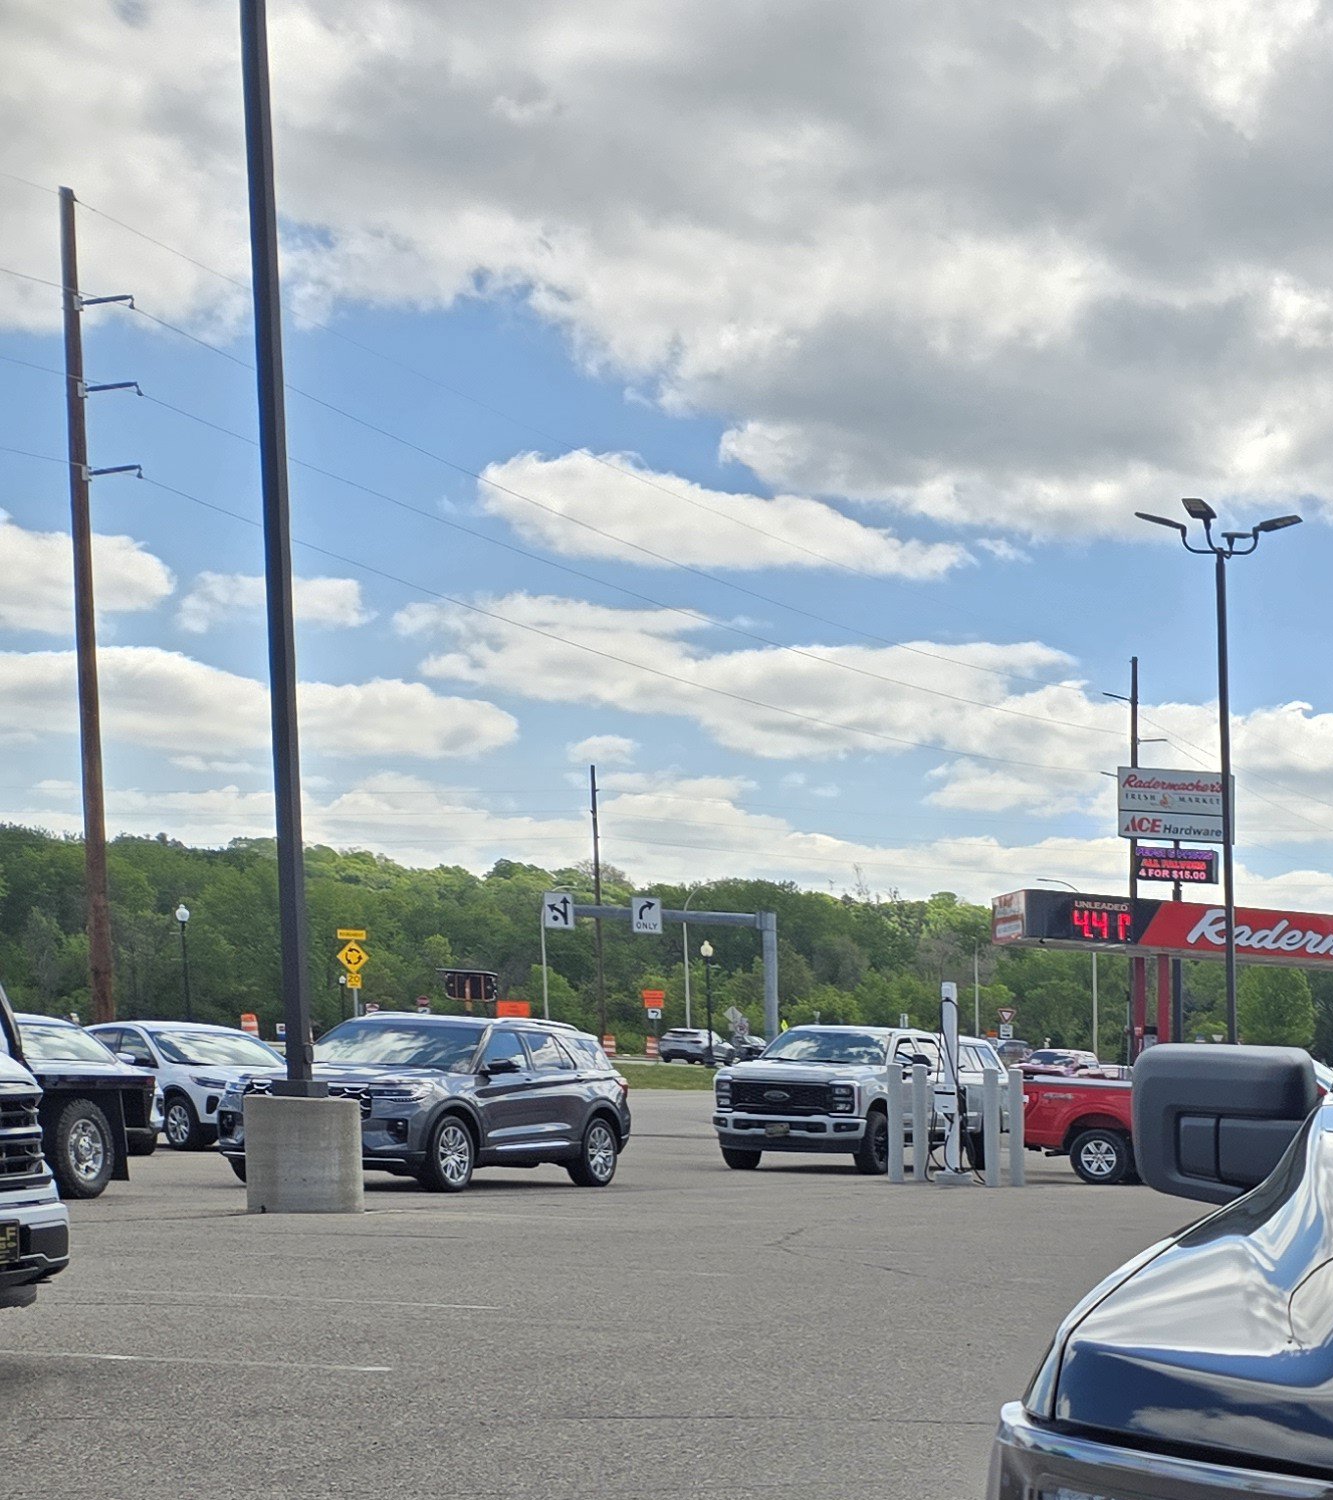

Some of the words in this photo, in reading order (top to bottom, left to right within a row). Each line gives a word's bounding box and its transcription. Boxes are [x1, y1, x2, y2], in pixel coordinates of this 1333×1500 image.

[1124, 815, 1162, 833] ACE
[1163, 824, 1222, 837] Hardware
[1148, 869, 1170, 878] FOR
[1074, 900, 1128, 911] UNLEADED
[636, 921, 658, 930] ONLY
